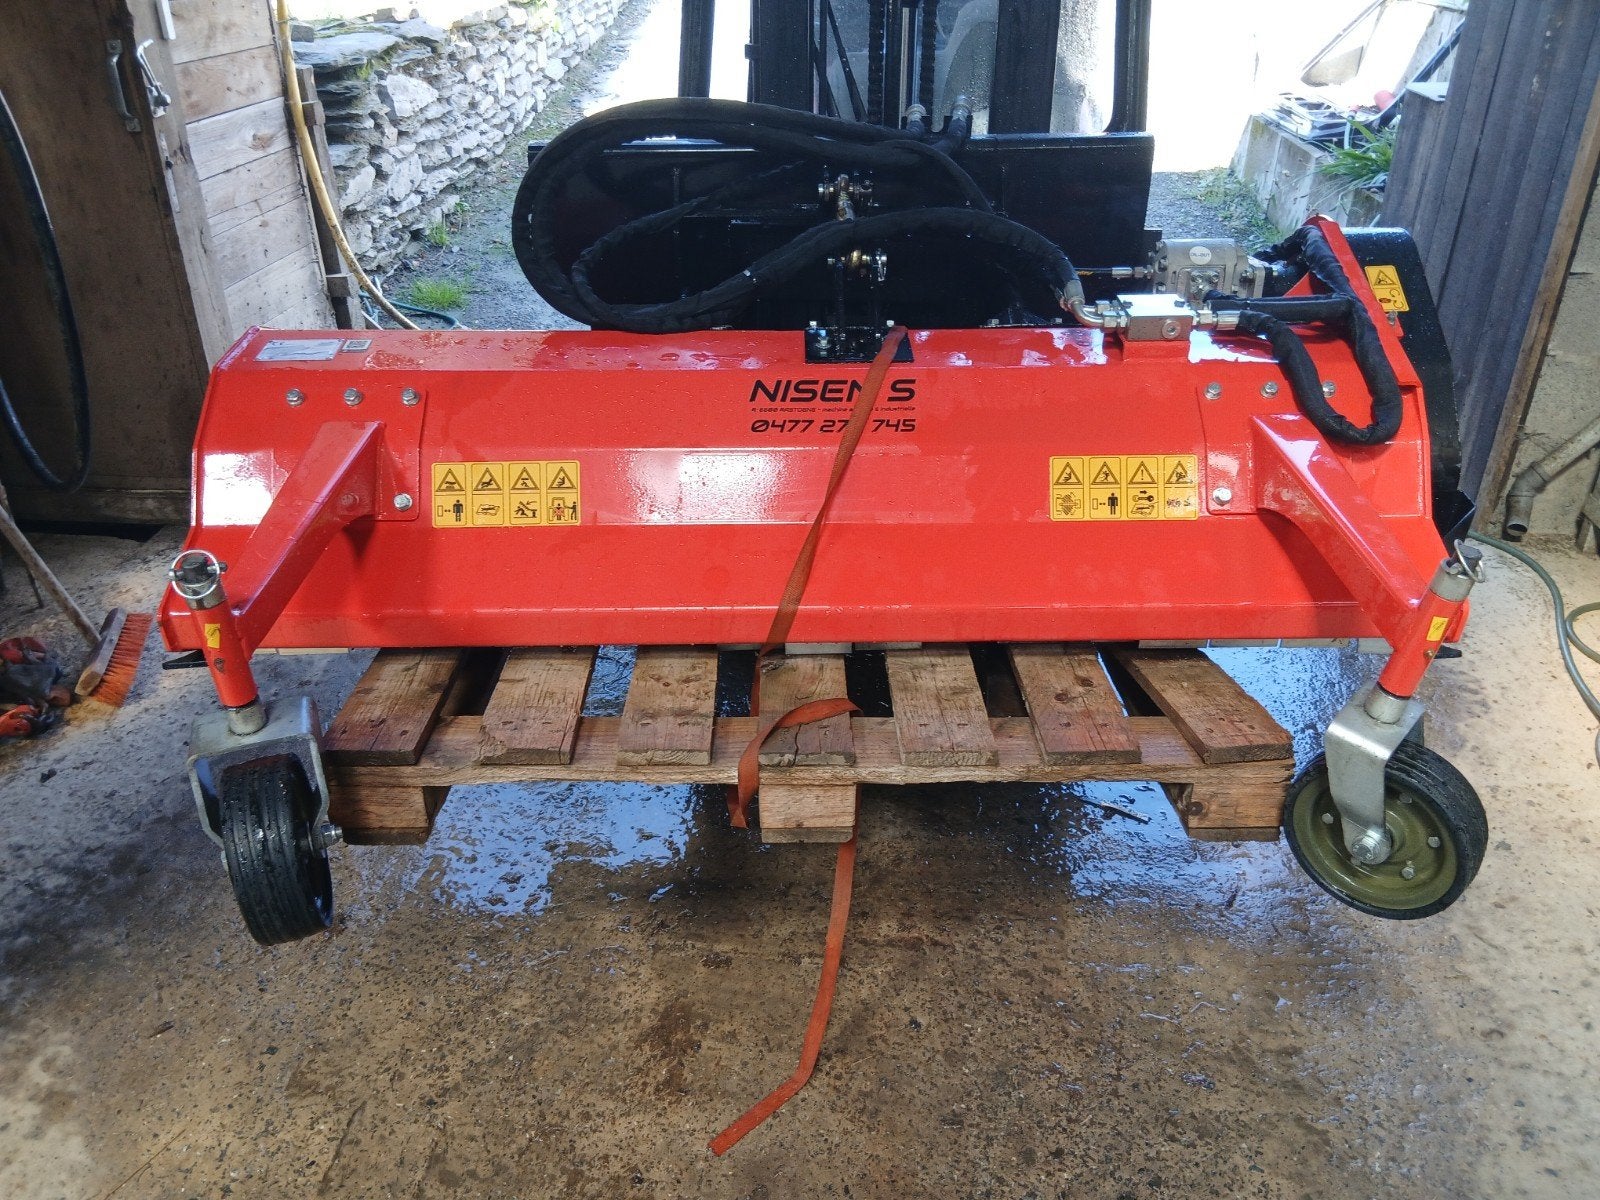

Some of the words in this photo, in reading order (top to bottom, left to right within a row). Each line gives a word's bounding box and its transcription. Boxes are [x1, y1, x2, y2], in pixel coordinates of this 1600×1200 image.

[751, 419, 814, 433] 0477
[820, 419, 854, 433] 27
[871, 418, 916, 433] 745
